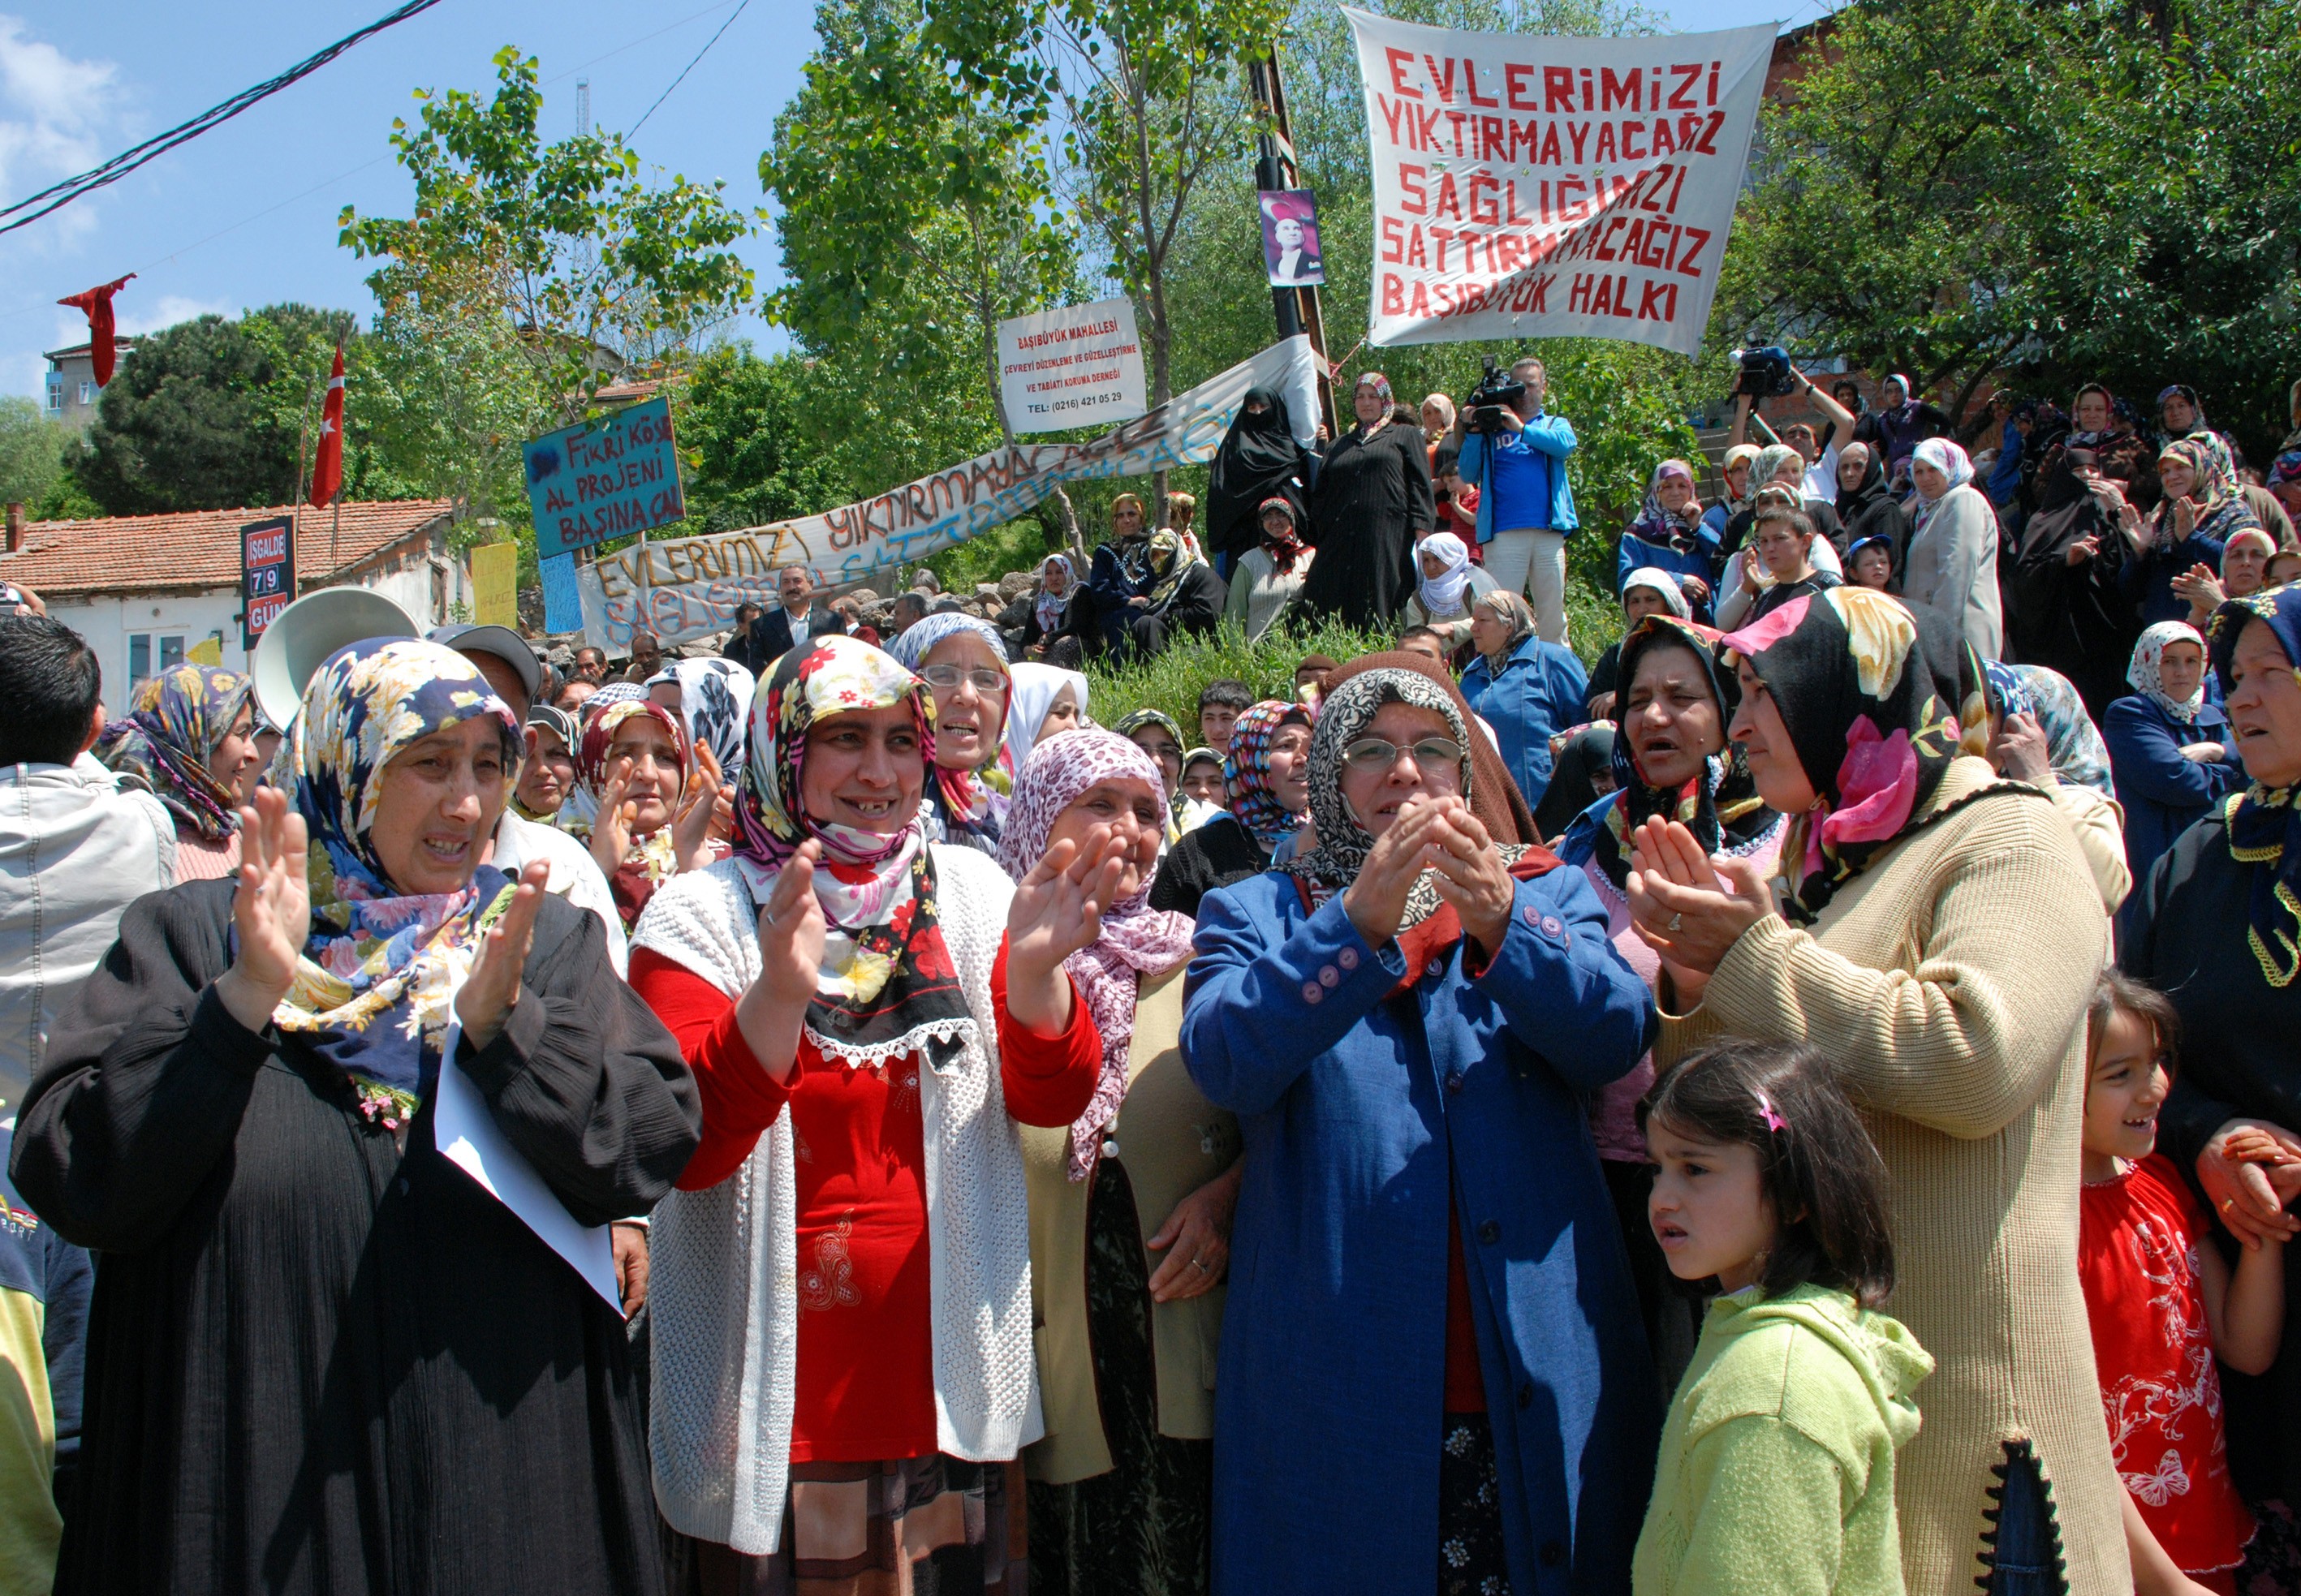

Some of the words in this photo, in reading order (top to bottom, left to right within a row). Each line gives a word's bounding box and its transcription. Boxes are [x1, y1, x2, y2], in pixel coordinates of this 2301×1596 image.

[1568, 273, 1678, 322] HALKI
[1018, 329, 1067, 350] BAŞIBÜYÜK
[1070, 317, 1118, 339] MAHALLESİ
[1005, 360, 1034, 376] ÇEVREYİ
[1036, 355, 1073, 371] DÜZENLEME
[1074, 352, 1083, 364] VE
[1084, 344, 1136, 361] GÜZELLEŞTİRME
[1026, 383, 1036, 393] VE
[1037, 378, 1063, 391] TABİATI
[1064, 374, 1091, 387] KORUMA
[1092, 368, 1120, 382] DERNEĞİ
[1027, 404, 1049, 414] TEL:
[1052, 398, 1079, 412] (0216)
[1080, 395, 1097, 406] 421
[1098, 394, 1110, 404] 05
[1112, 392, 1122, 402] 29
[545, 487, 574, 514] AL
[558, 497, 648, 546] BAŞINA
[250, 536, 284, 565] İŞGALDE
[253, 570, 276, 591] 79
